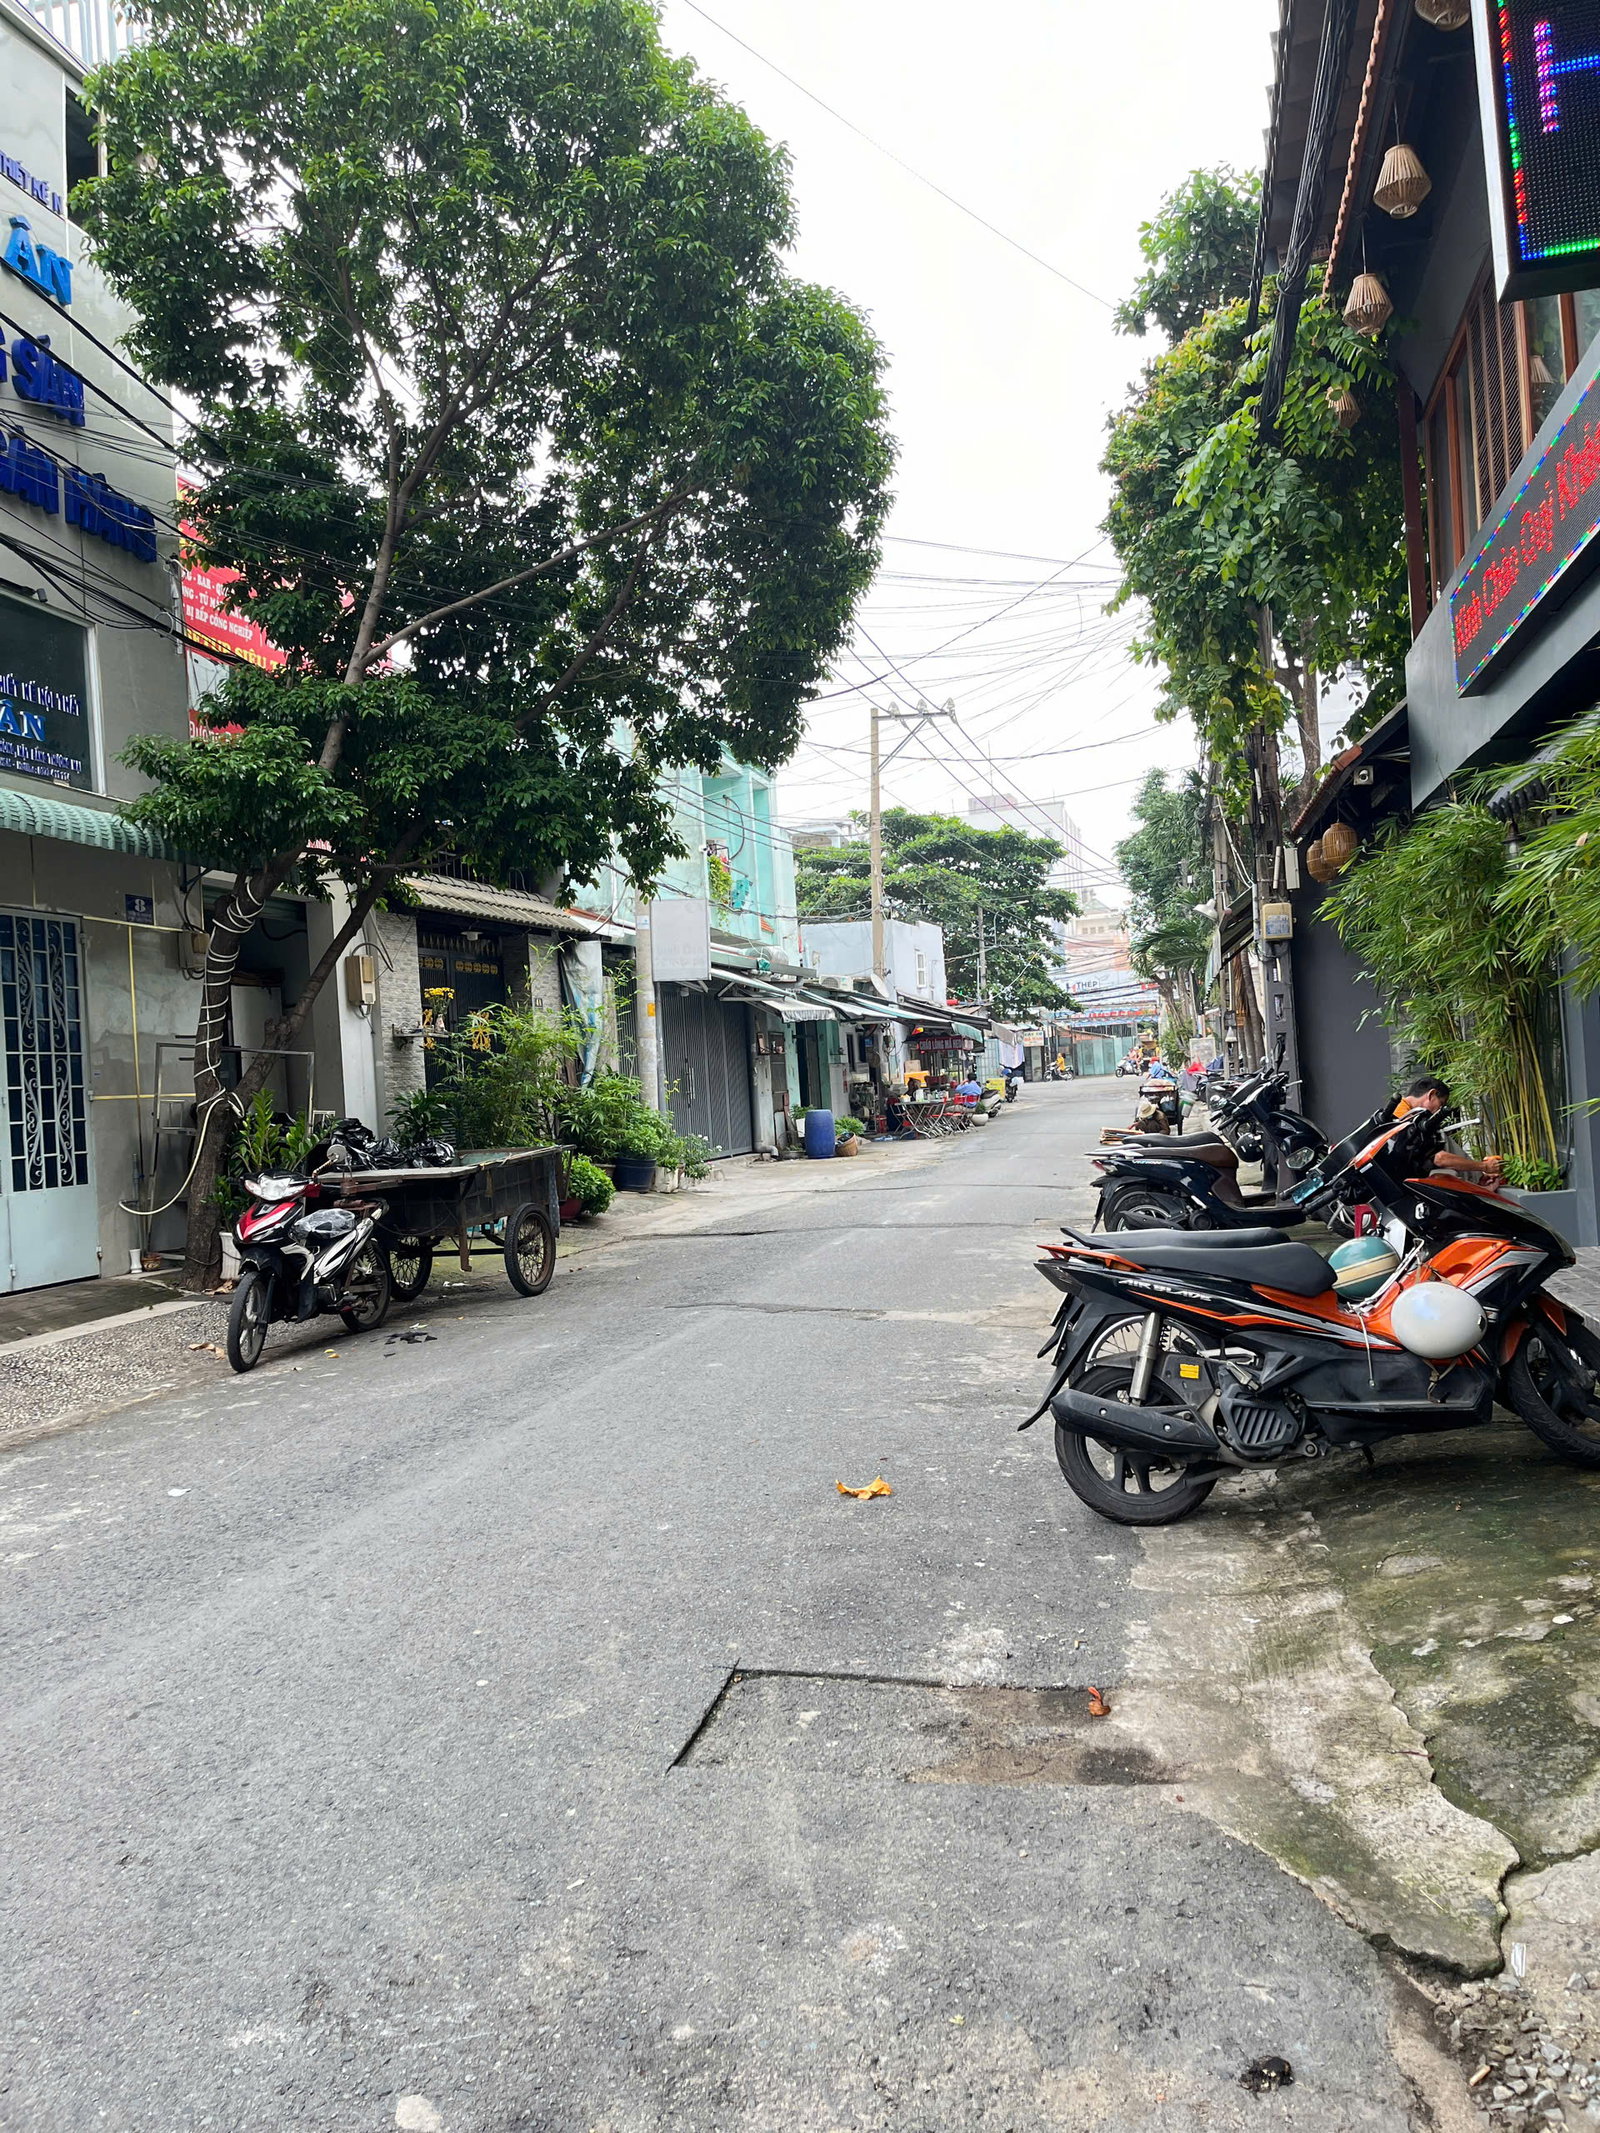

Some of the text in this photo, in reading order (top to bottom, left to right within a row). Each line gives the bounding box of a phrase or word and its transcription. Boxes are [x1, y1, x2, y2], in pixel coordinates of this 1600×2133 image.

[134, 898, 146, 913] 8
[1118, 1279, 1212, 1303] AIR BLADE
